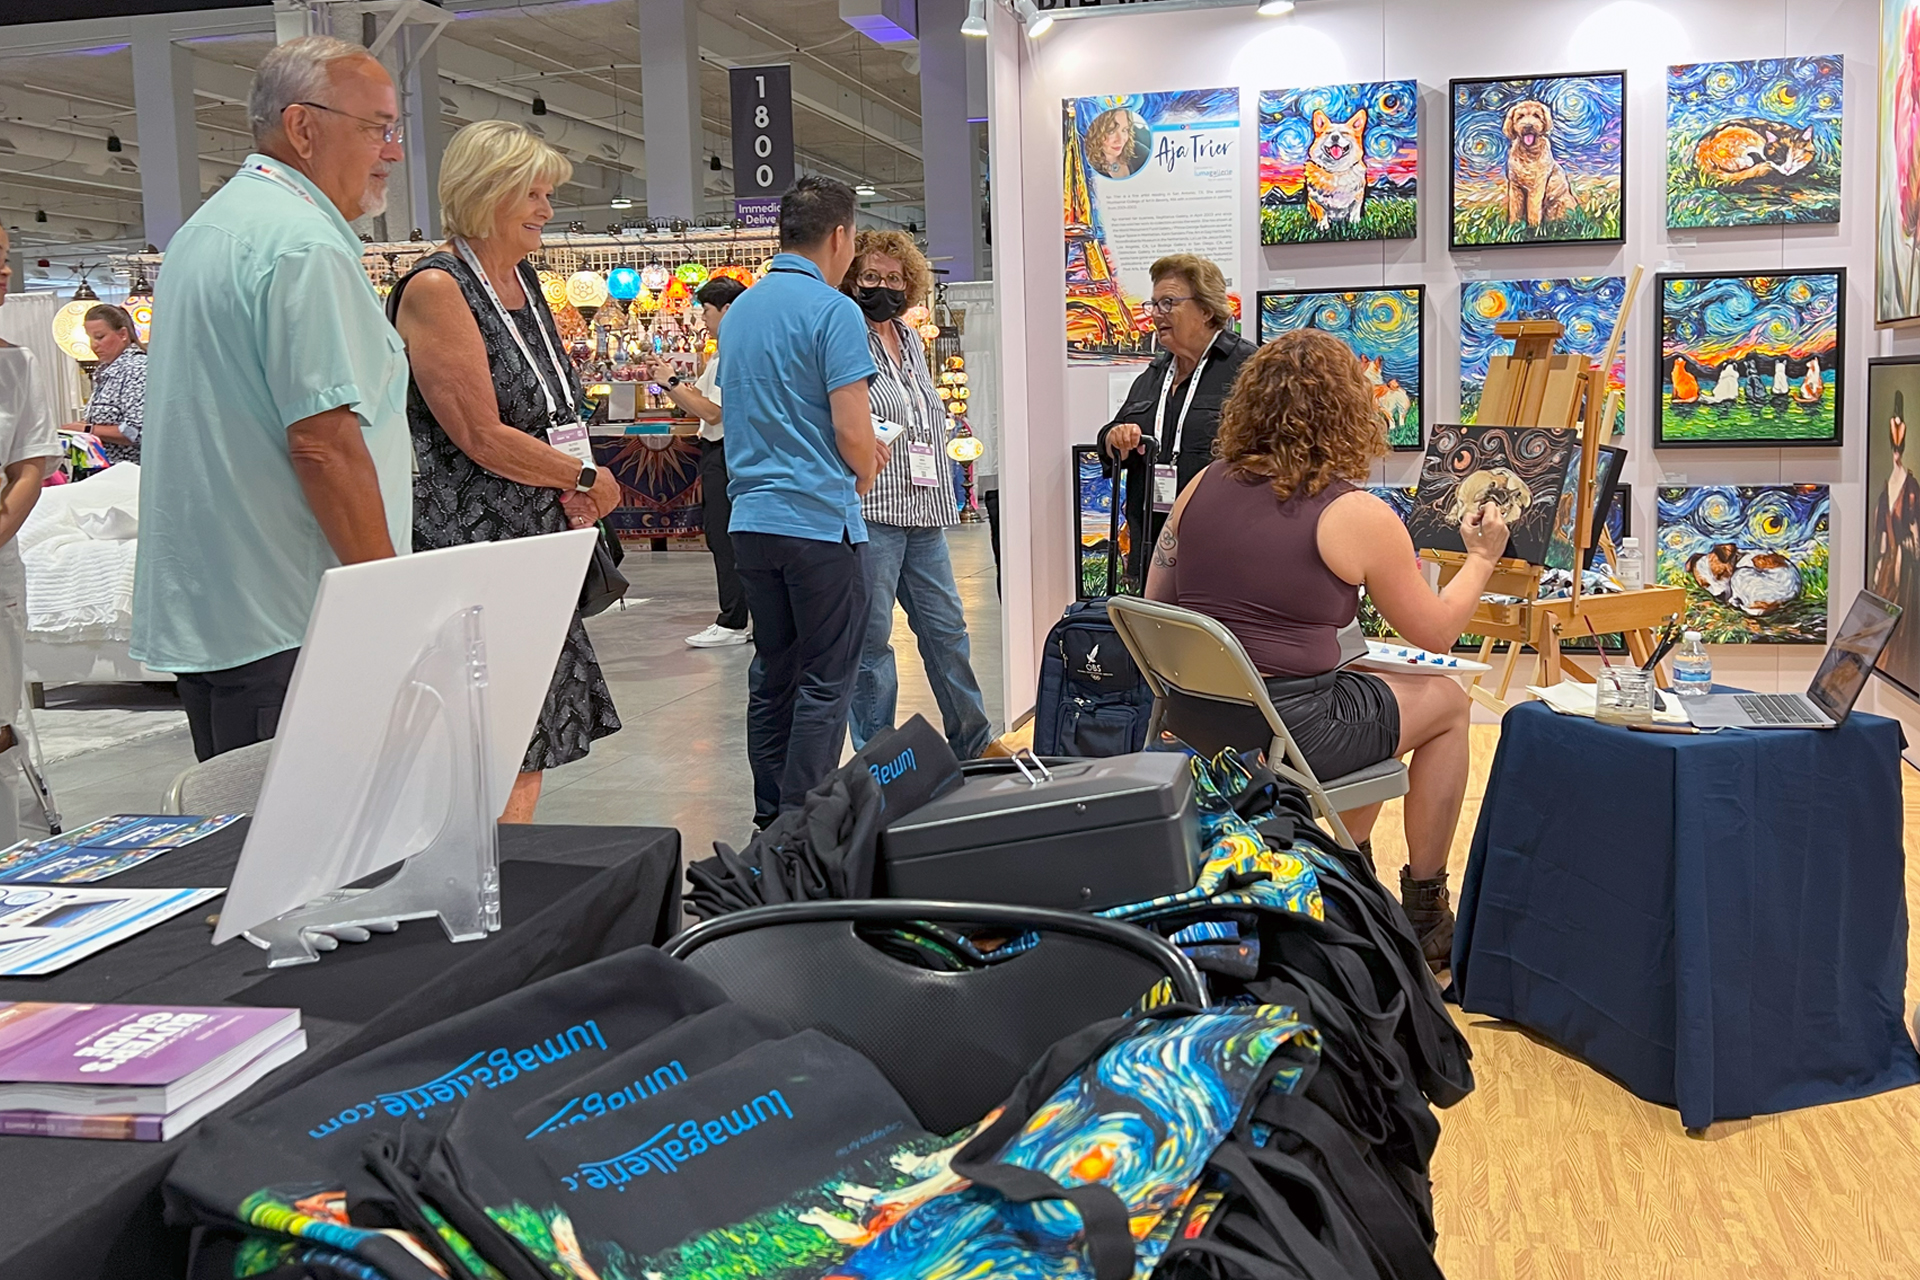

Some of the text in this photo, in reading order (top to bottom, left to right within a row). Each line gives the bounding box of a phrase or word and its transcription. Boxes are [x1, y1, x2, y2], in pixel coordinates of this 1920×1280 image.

[754, 75, 774, 187] 1800
[1154, 133, 1234, 173] Aja Trier
[72, 1011, 174, 1058] GUIDE
[79, 1012, 209, 1073] BUYER'S
